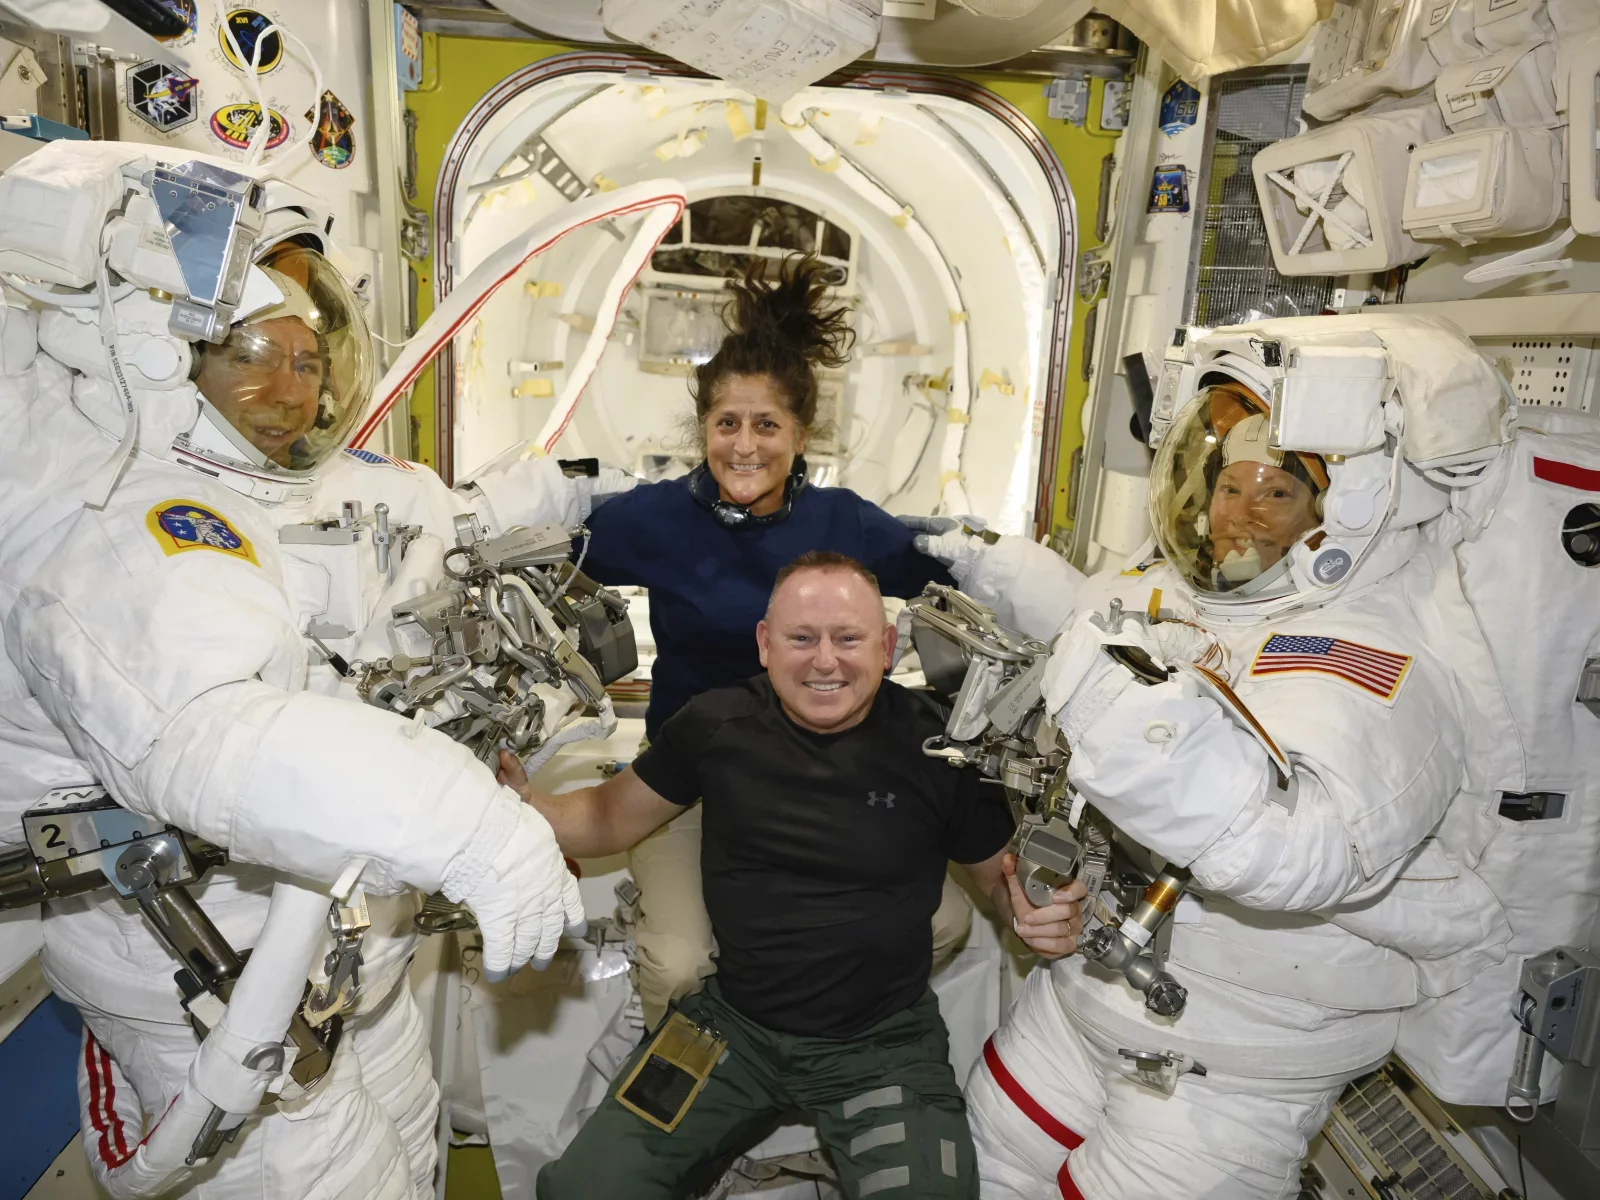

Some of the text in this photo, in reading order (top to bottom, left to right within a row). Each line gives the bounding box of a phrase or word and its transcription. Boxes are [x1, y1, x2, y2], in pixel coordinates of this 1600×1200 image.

[764, 39, 790, 61] EMU
[1175, 101, 1198, 117] 60
[1158, 193, 1167, 206] 59
[108, 344, 116, 357] P/N
[41, 823, 66, 848] 2
